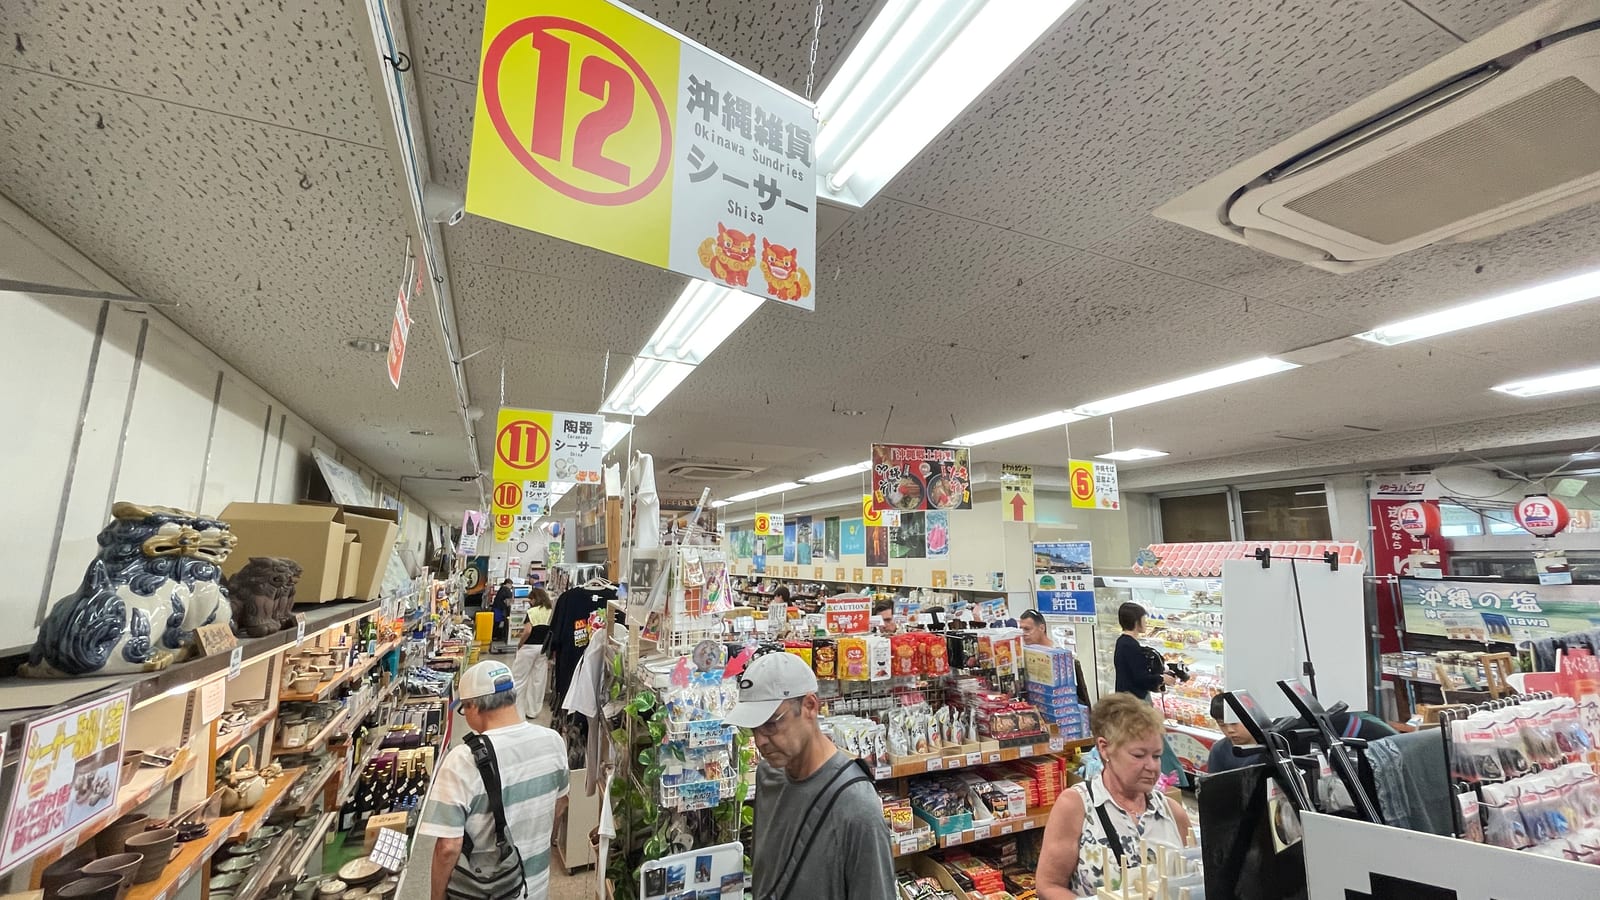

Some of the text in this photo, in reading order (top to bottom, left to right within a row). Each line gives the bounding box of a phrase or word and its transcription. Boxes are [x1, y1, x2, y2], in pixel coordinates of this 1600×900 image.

[530, 28, 636, 187] 12
[685, 74, 812, 168] 沖縄雑貨
[693, 121, 805, 182] Okinawa Sundries
[685, 144, 809, 214] シーサー
[726, 199, 765, 226] Shisa
[563, 419, 593, 435] 陶器
[508, 424, 539, 463] 11
[554, 439, 601, 453] シーサー
[499, 485, 517, 506] 10
[1076, 471, 1089, 496] 5
[1526, 504, 1549, 517] 塩
[758, 518, 767, 530] 3
[1051, 598, 1078, 611] 許田
[1419, 587, 1543, 613] 沖縄の塩
